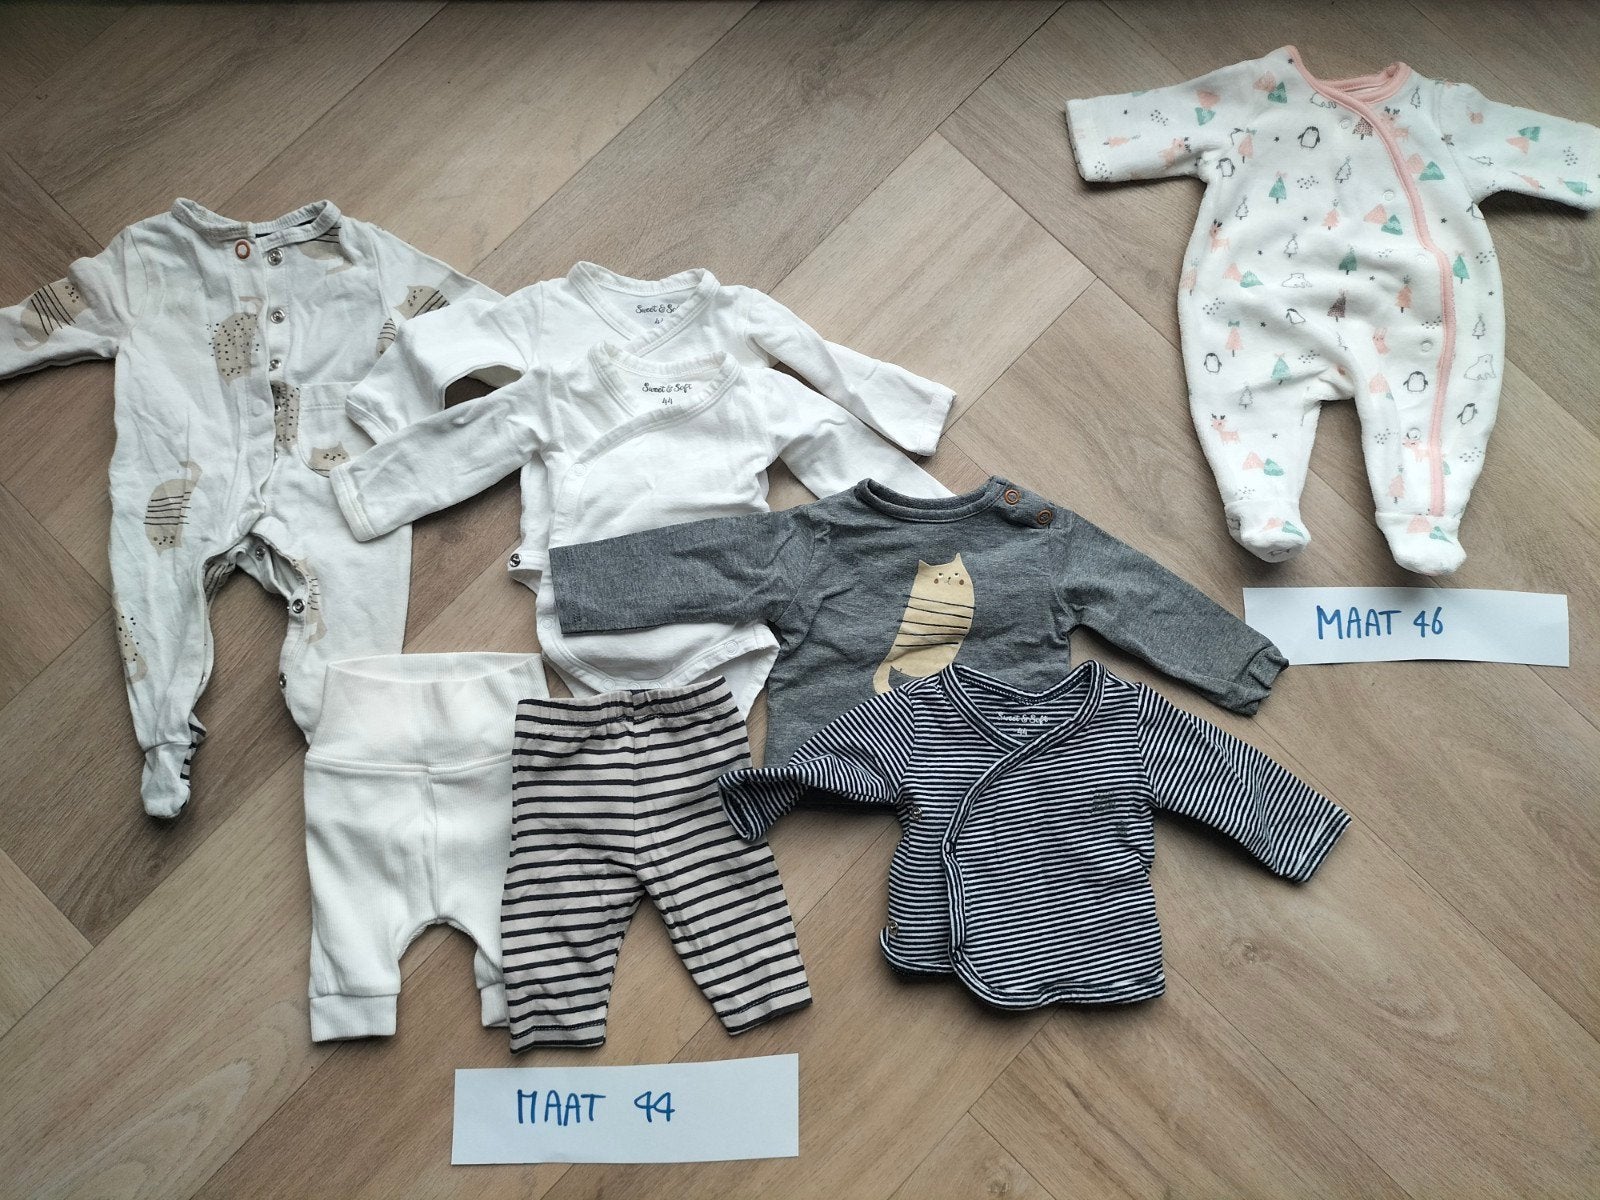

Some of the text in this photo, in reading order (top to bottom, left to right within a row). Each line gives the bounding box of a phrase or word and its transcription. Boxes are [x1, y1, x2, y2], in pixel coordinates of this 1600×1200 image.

[635, 305, 657, 314] Sweet
[659, 304, 665, 313] &
[642, 382, 692, 394] Sweet & Soft
[661, 397, 673, 405] 44
[1316, 605, 1444, 640] MAAT 46
[516, 1088, 676, 1127] MAAT 44
